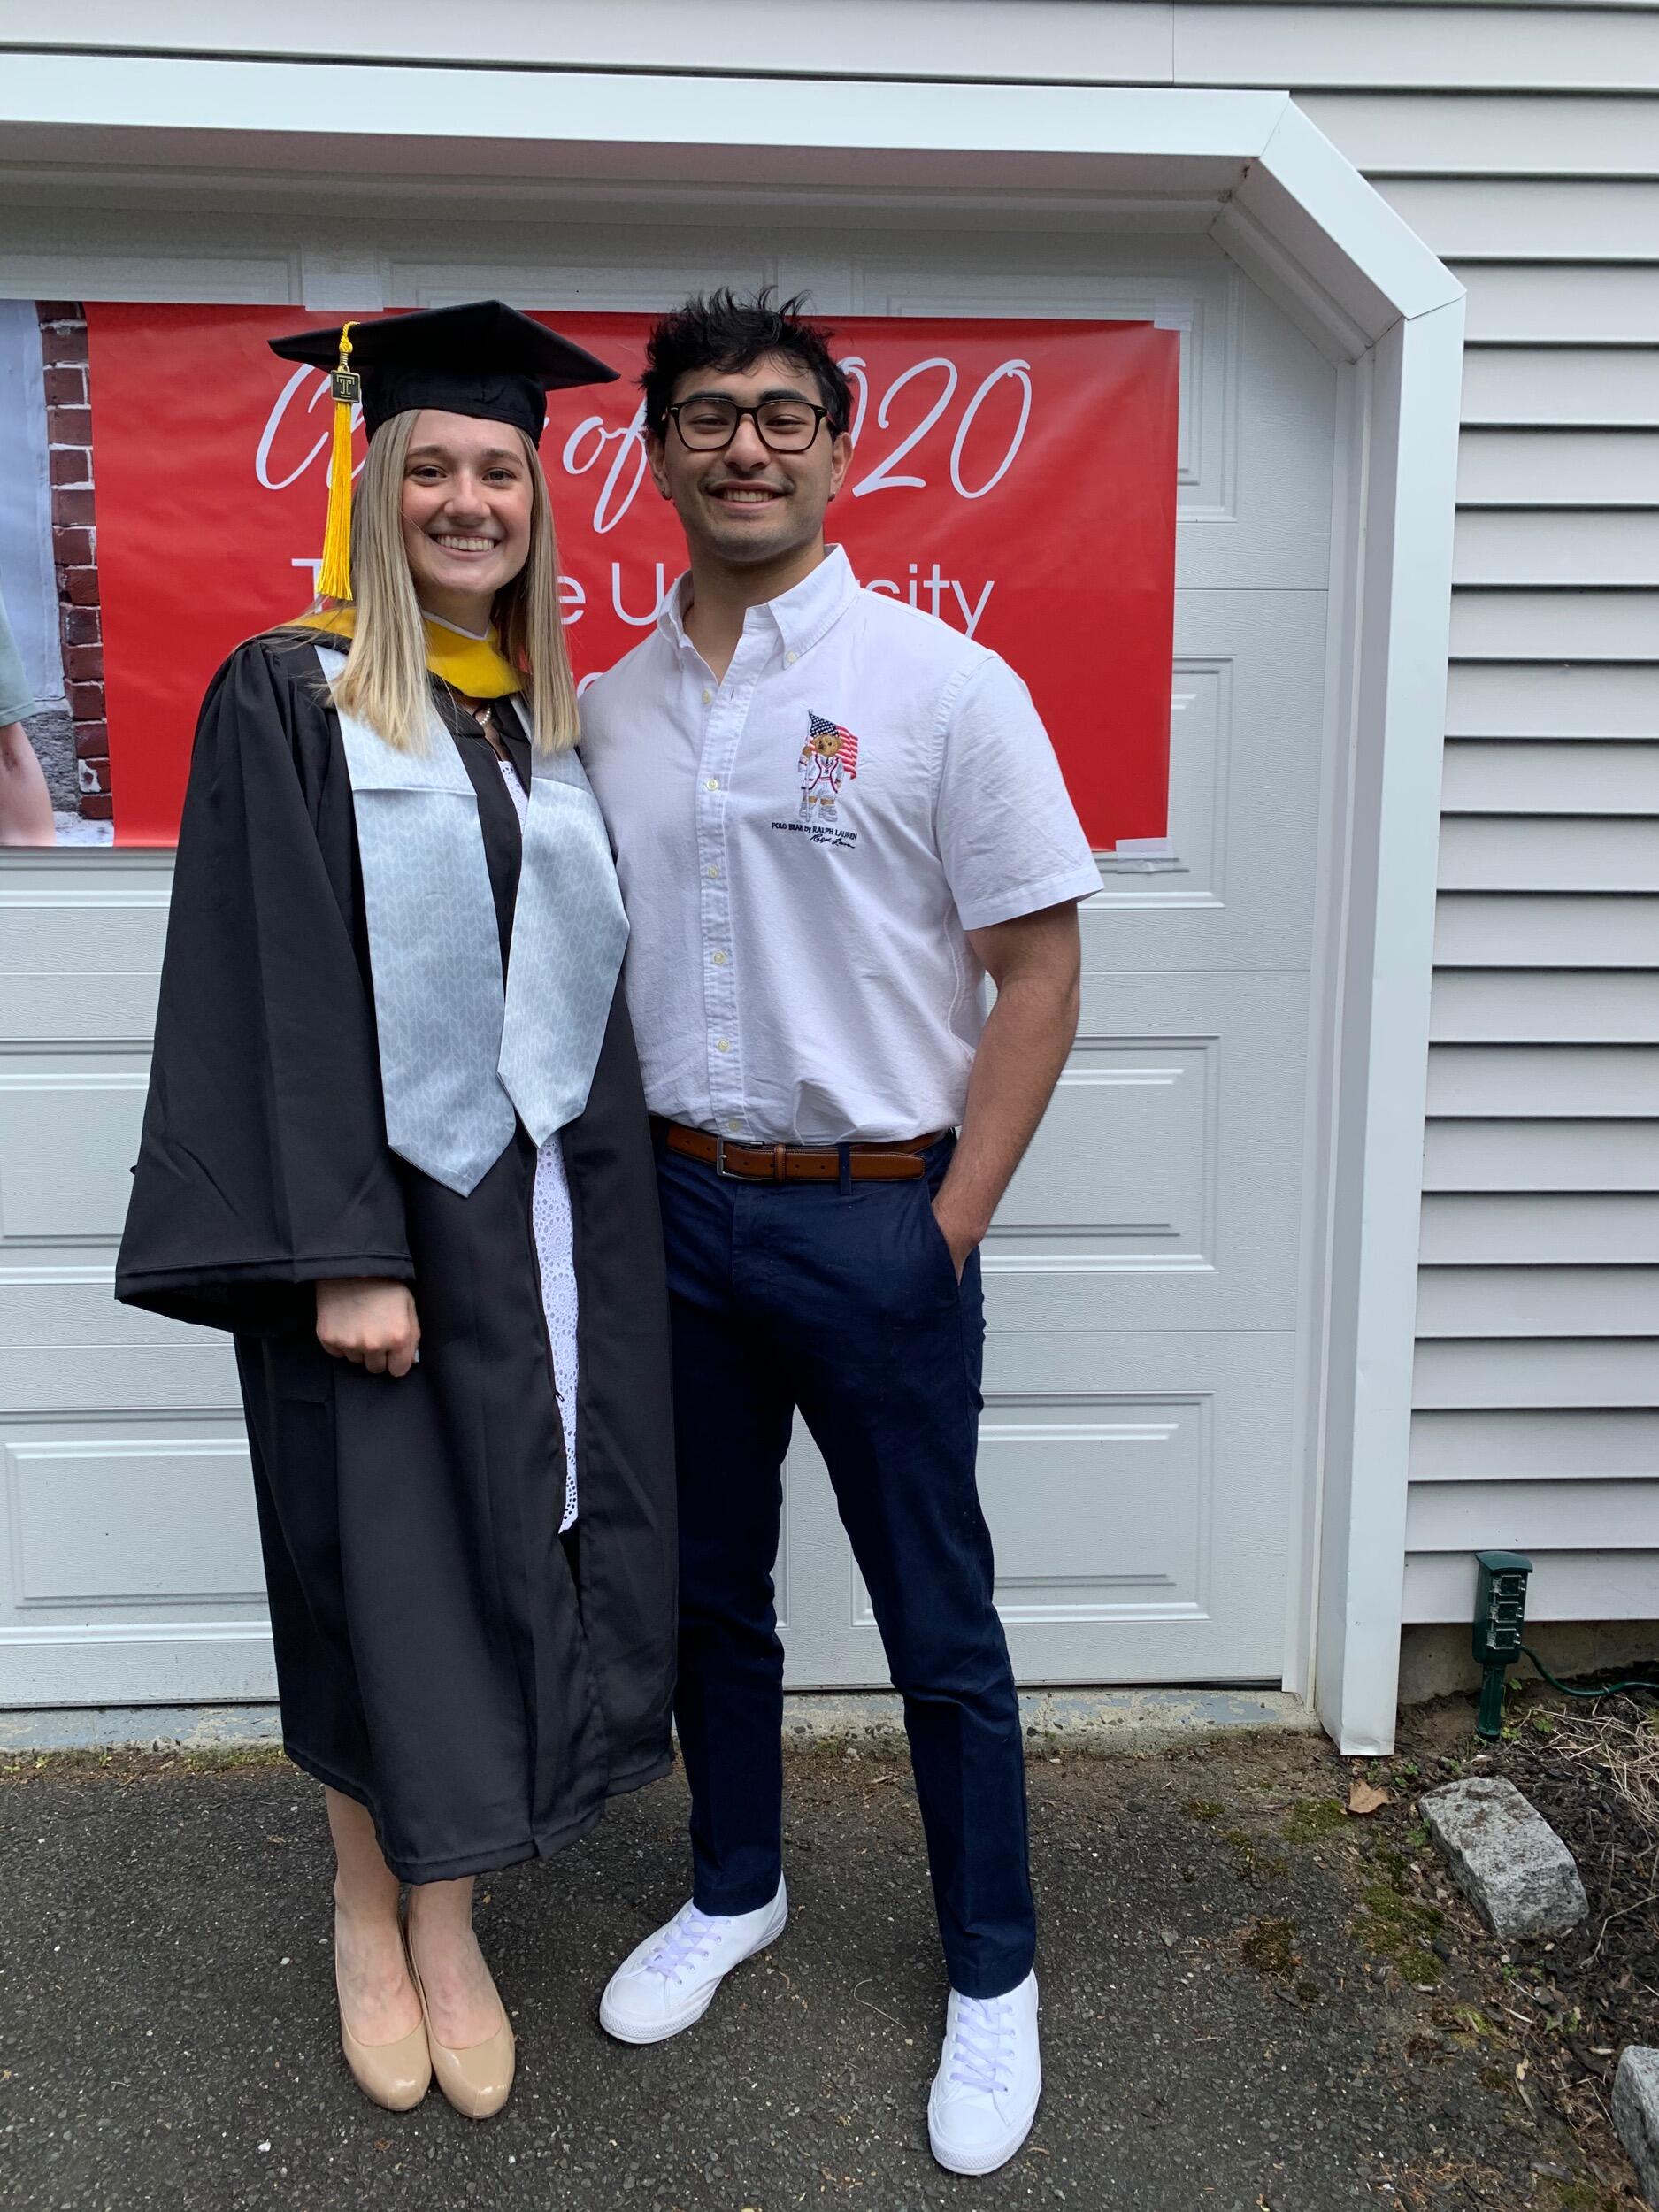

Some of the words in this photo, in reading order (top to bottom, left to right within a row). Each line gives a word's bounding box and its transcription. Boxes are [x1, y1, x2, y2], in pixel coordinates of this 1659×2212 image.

[562, 396, 648, 534] of
[788, 823, 803, 832] BEAR
[812, 826, 833, 834] RALPH
[835, 829, 857, 840] LAUREN
